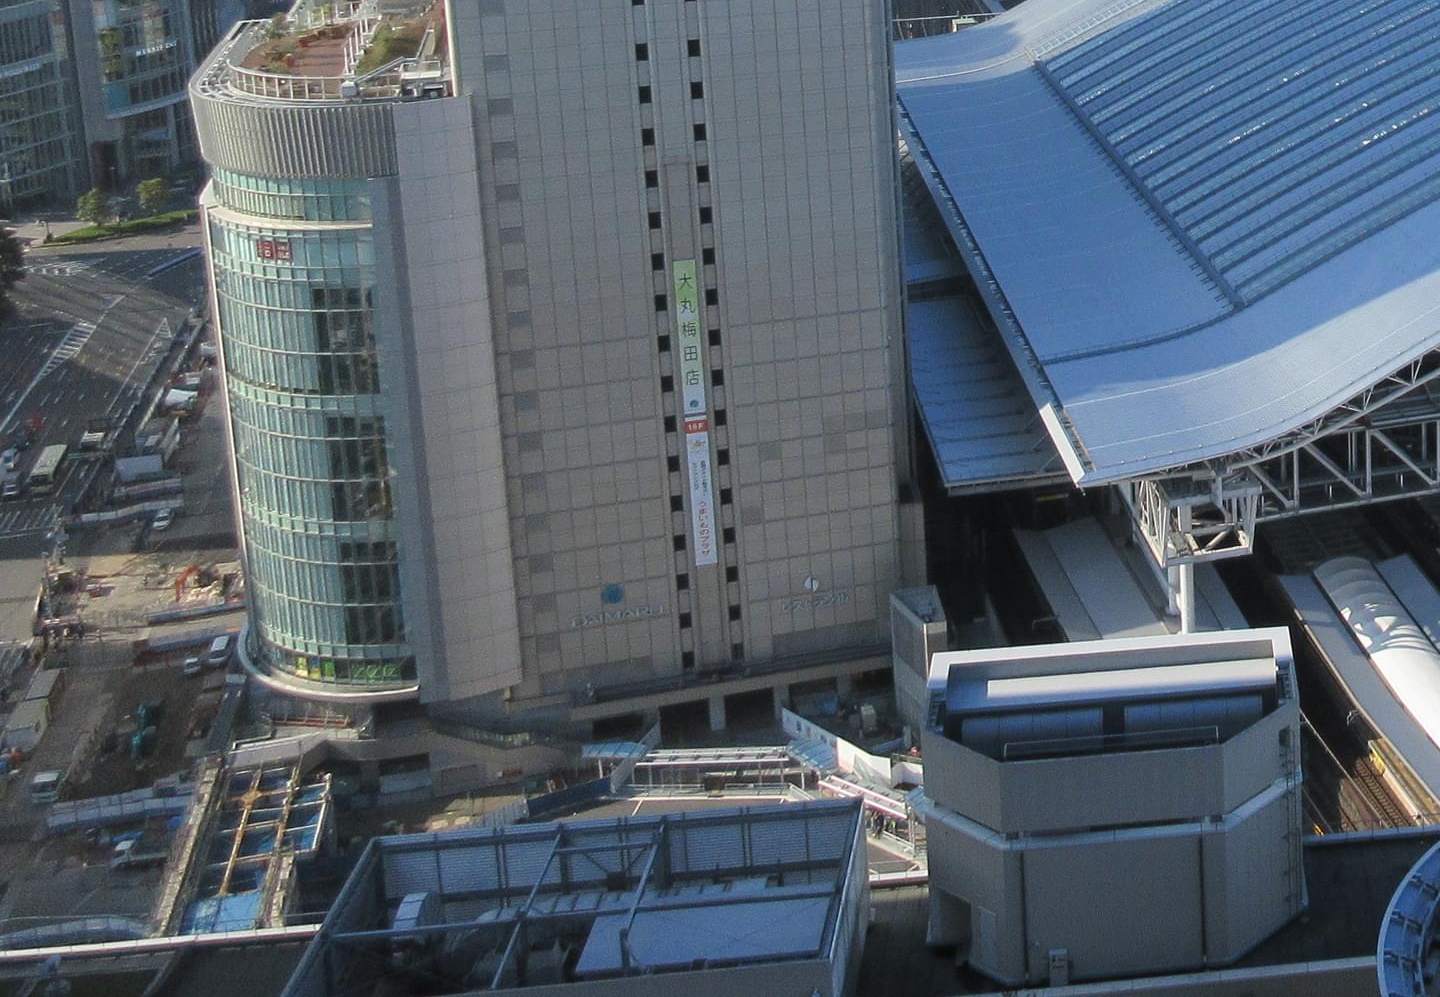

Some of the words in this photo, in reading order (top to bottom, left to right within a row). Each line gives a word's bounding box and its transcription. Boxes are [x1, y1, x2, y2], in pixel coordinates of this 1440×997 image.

[679, 272, 700, 387] 大丸梅田店
[570, 603, 664, 628] DAIMARU
